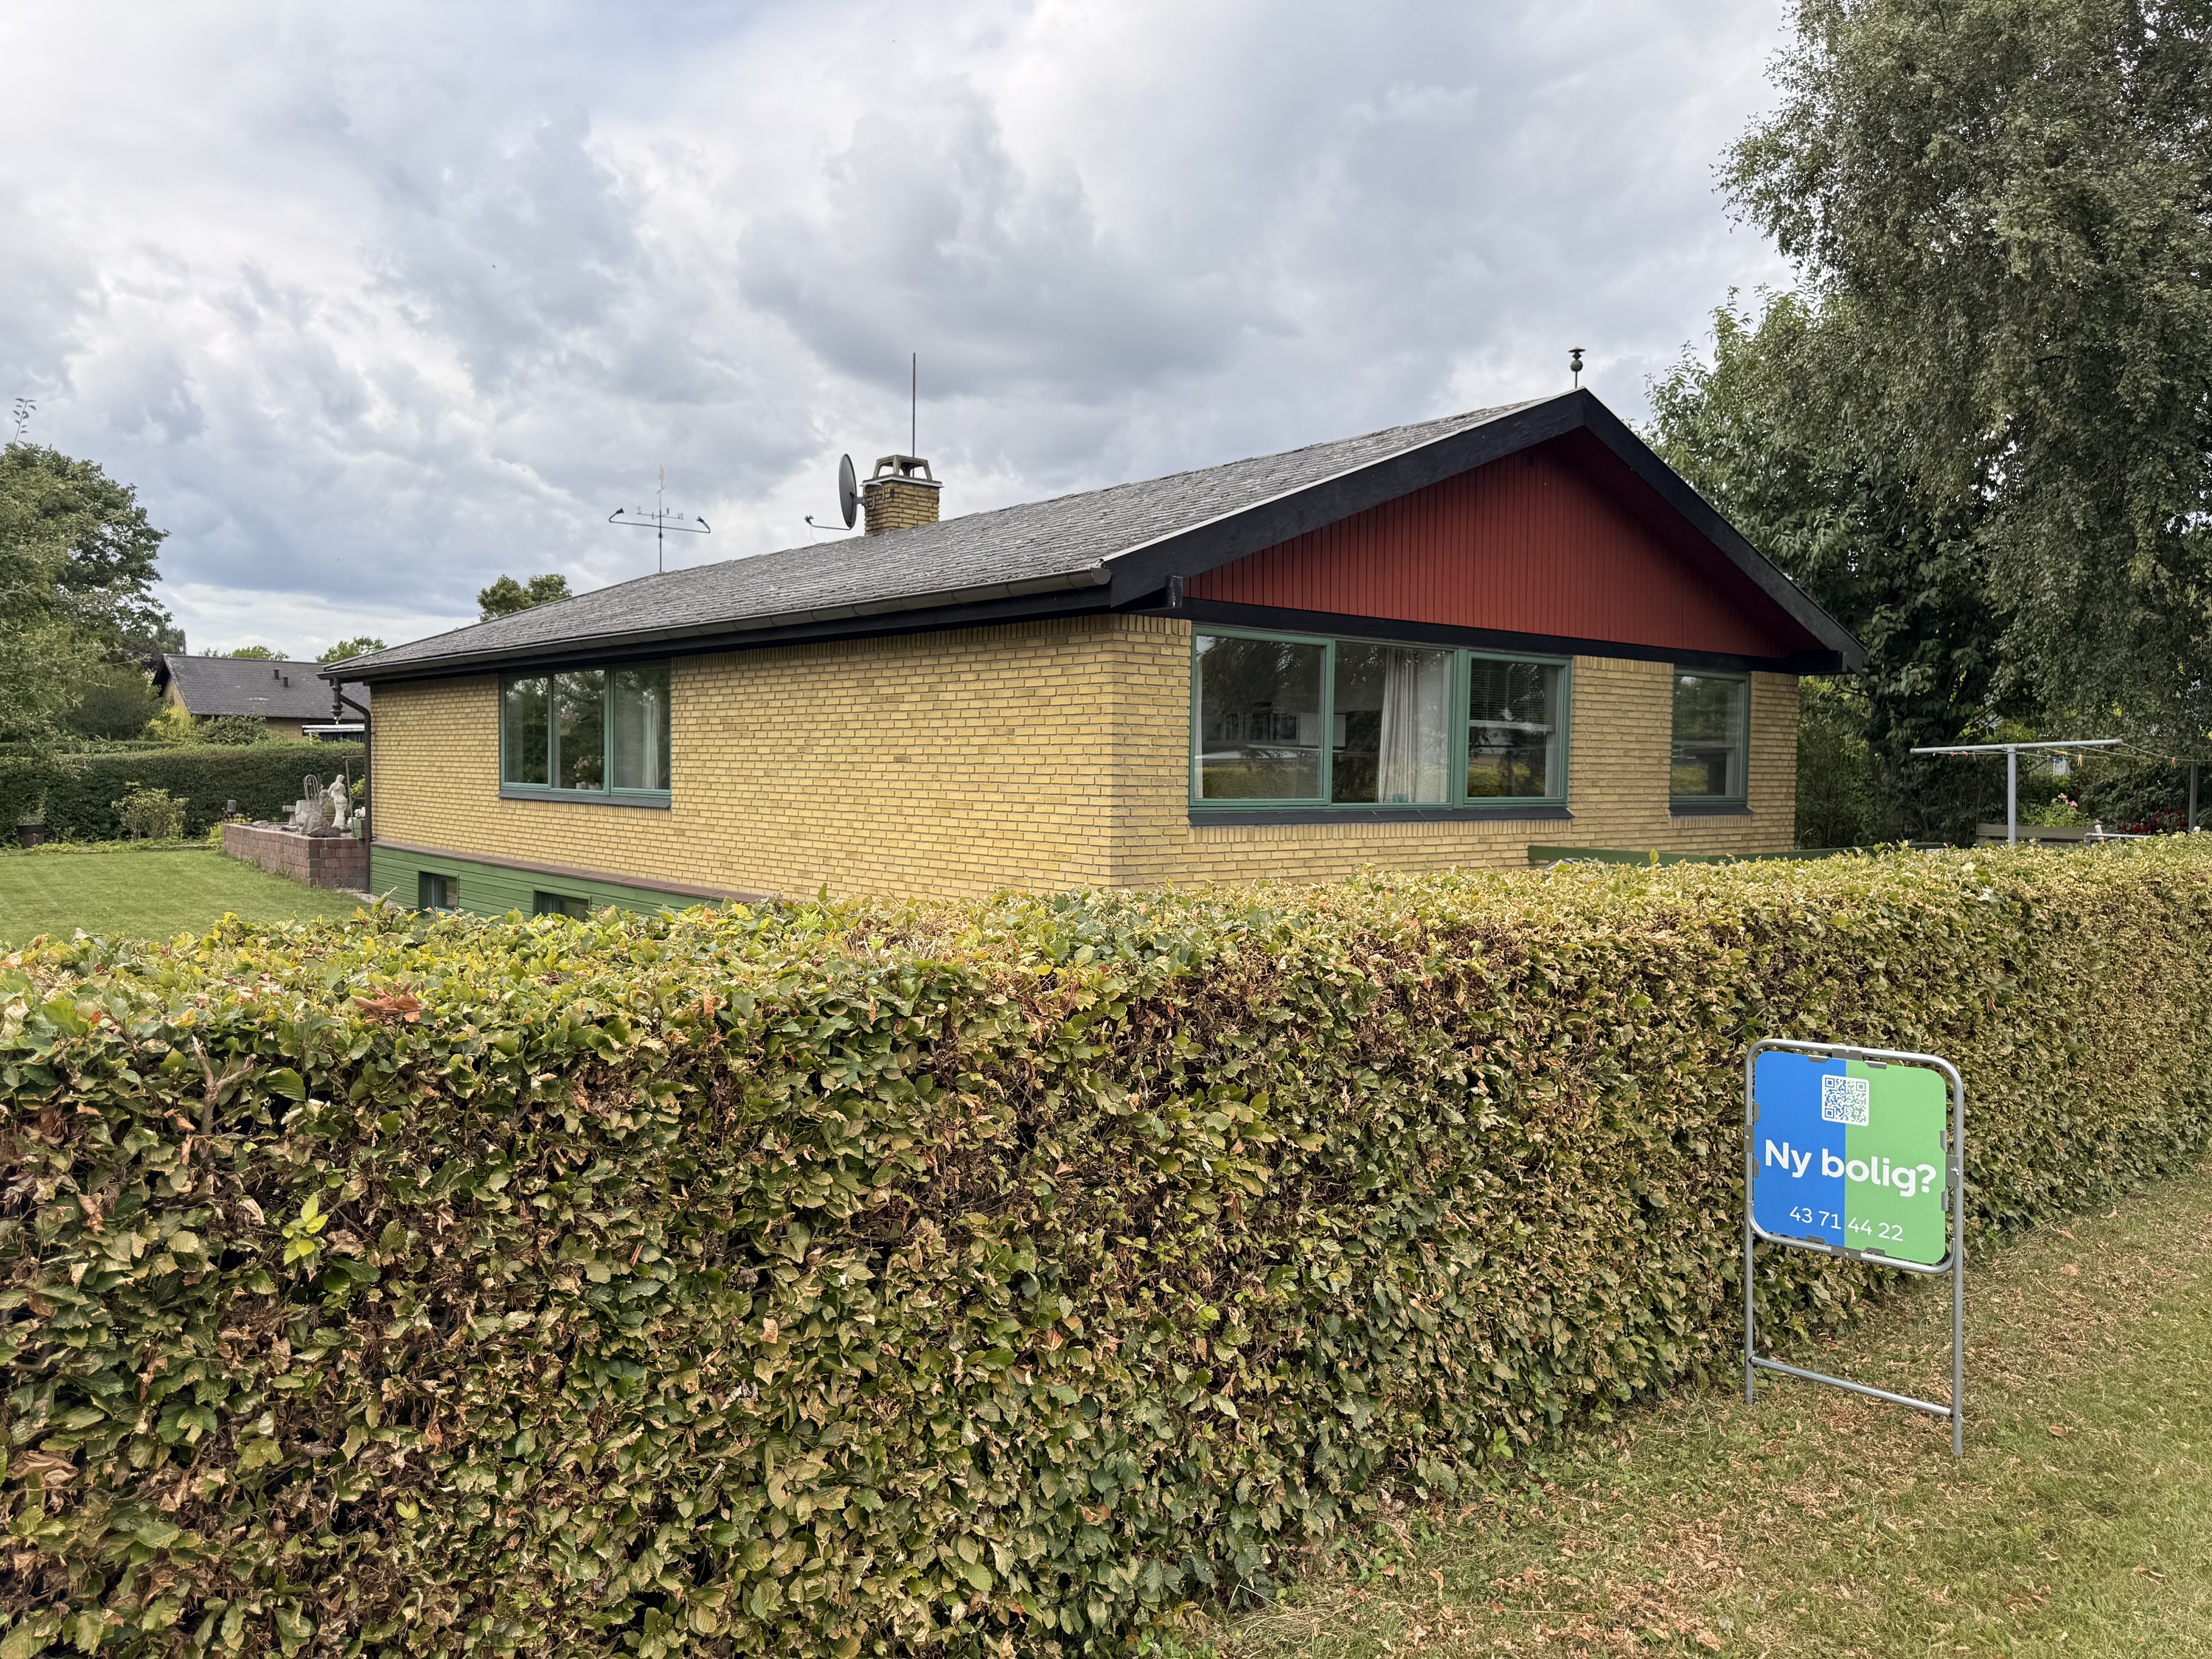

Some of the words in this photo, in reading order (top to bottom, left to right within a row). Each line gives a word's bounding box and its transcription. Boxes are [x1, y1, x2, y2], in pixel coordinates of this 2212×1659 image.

[1765, 1139, 1812, 1178] Ny
[1821, 1148, 1937, 1197] bolig?
[1789, 1206, 1813, 1223] 43
[1818, 1211, 1842, 1230] 71
[1847, 1217, 1873, 1236] 44
[1878, 1222, 1904, 1242] 22
